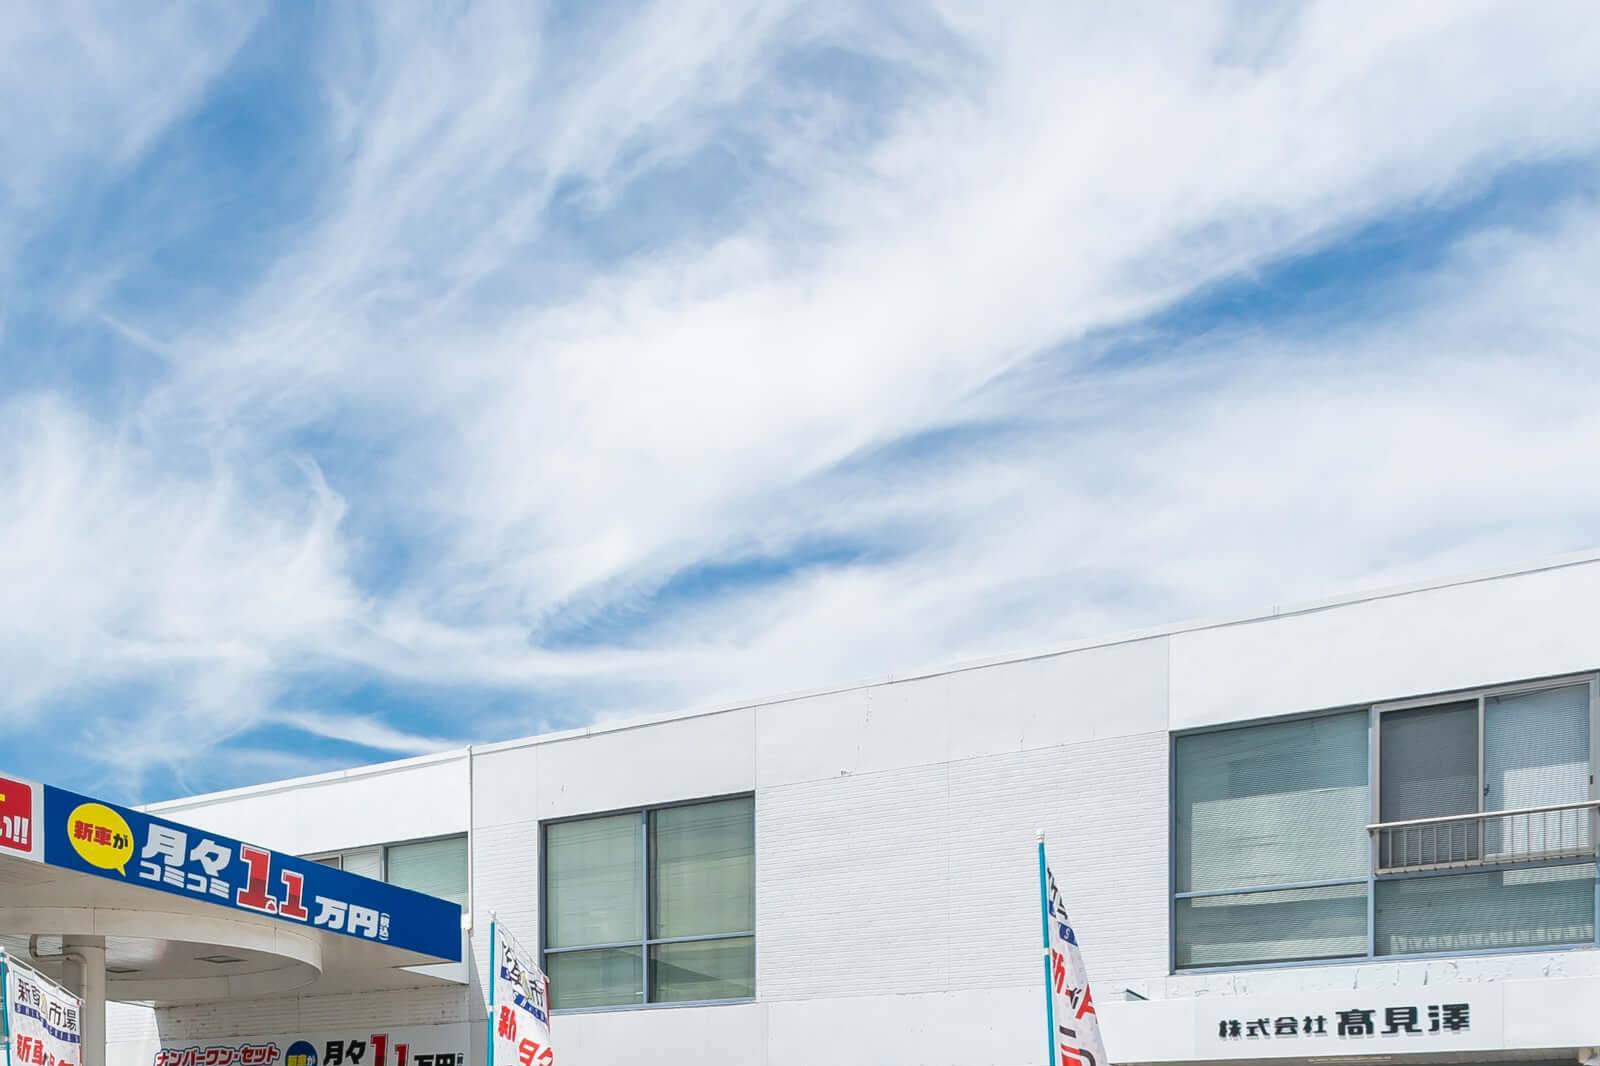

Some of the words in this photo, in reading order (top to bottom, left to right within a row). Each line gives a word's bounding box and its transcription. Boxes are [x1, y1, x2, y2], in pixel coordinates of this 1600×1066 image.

[73, 819, 129, 850] 新車が
[141, 823, 232, 876] 月々
[139, 860, 230, 899] コミコミ
[1218, 1014, 1328, 1039] 株式会社
[322, 1040, 367, 1066] 月々
